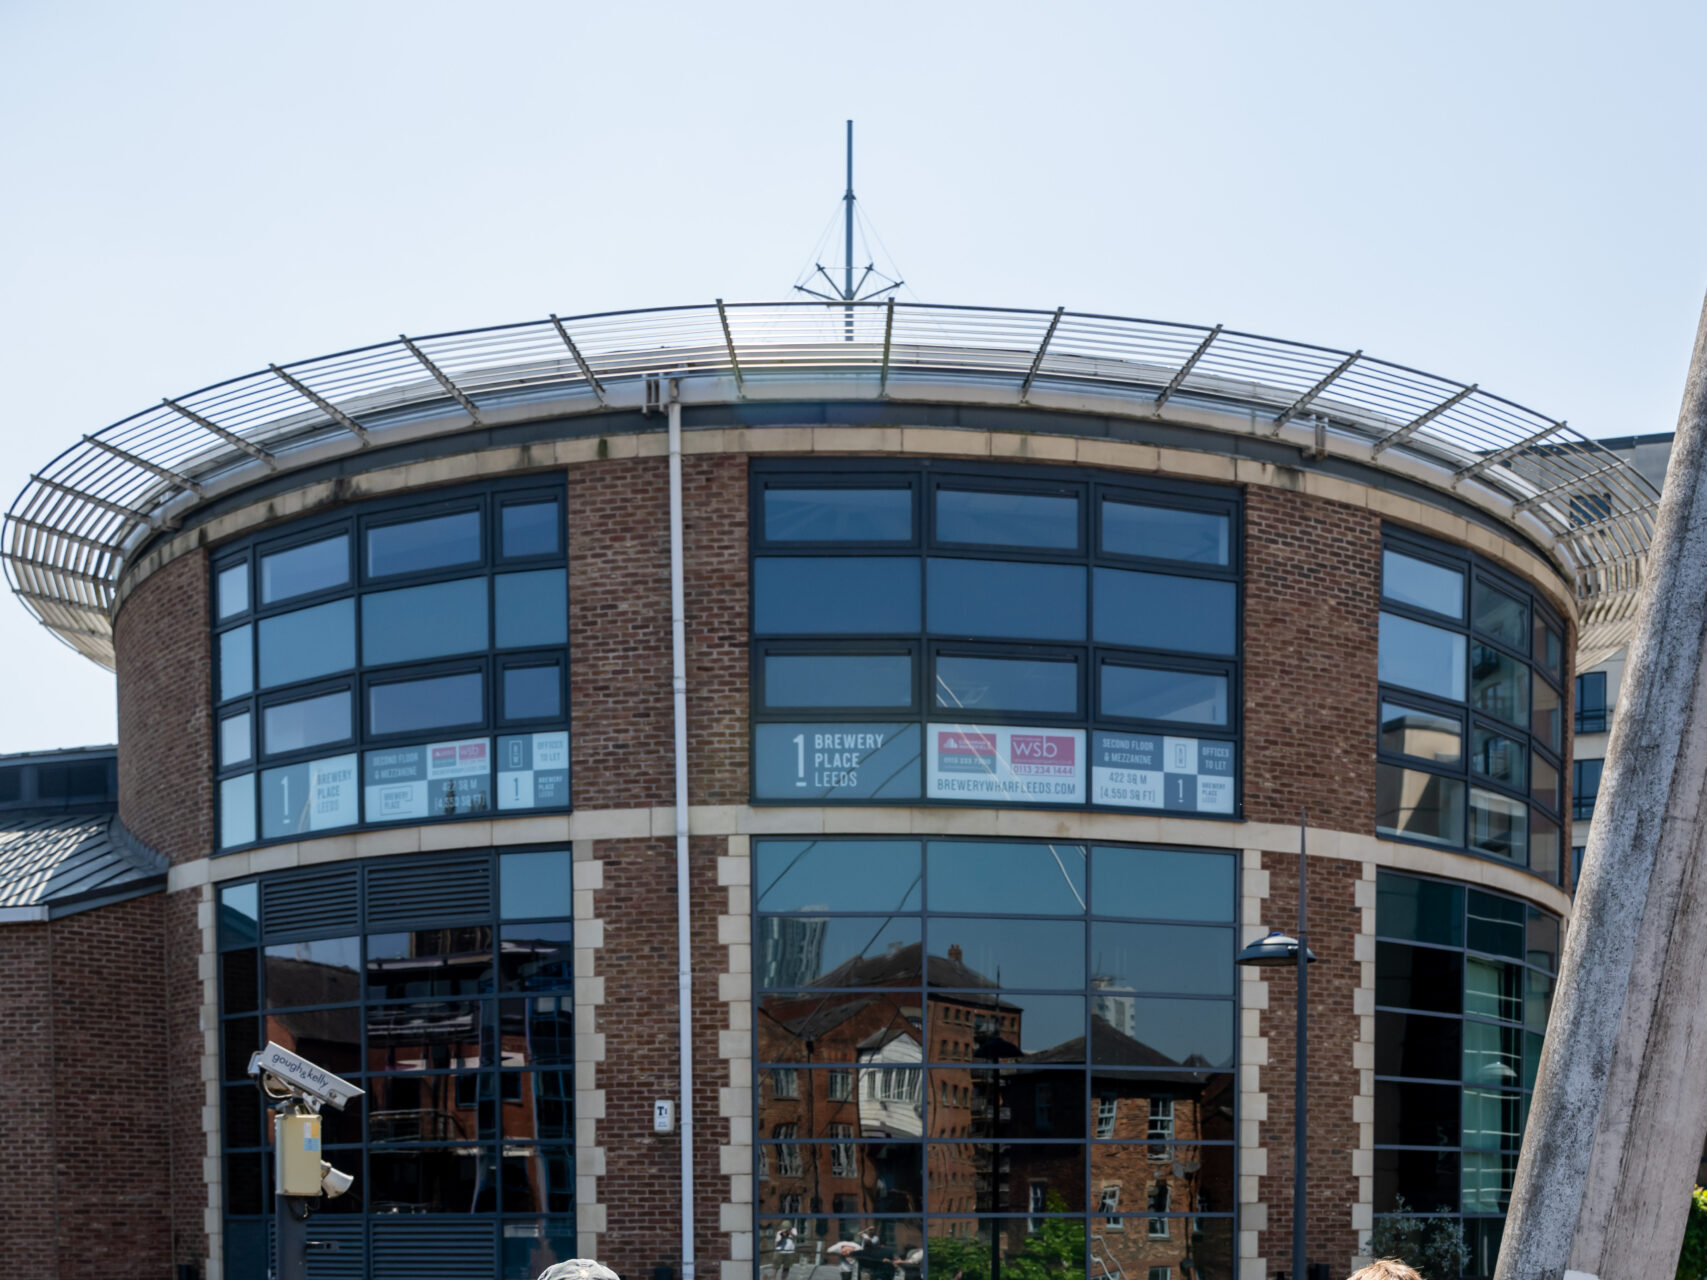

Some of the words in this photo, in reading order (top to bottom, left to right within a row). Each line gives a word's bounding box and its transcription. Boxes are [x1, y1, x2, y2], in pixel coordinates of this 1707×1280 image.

[814, 733, 884, 749] BREWERY
[1012, 736, 1058, 758] wsb
[1102, 738, 1130, 750] SECOND
[1131, 741, 1154, 752] FLOOR
[793, 734, 804, 778] 1
[814, 752, 860, 768] PLACE
[1111, 753, 1152, 765] MEZZANINE
[1202, 746, 1229, 758] OFFICES
[1035, 766, 1050, 775] 234
[1053, 767, 1073, 776] 1444
[1205, 760, 1213, 769] TO
[1215, 761, 1226, 770] LET
[317, 769, 353, 785] BREWERY
[814, 771, 857, 787] LEEDS
[1109, 771, 1125, 784] 422
[1140, 774, 1147, 785] M
[317, 785, 340, 799] PLACE
[937, 778, 1076, 795] BREWERYWHARFLEEDS.COM
[281, 775, 289, 816] 1
